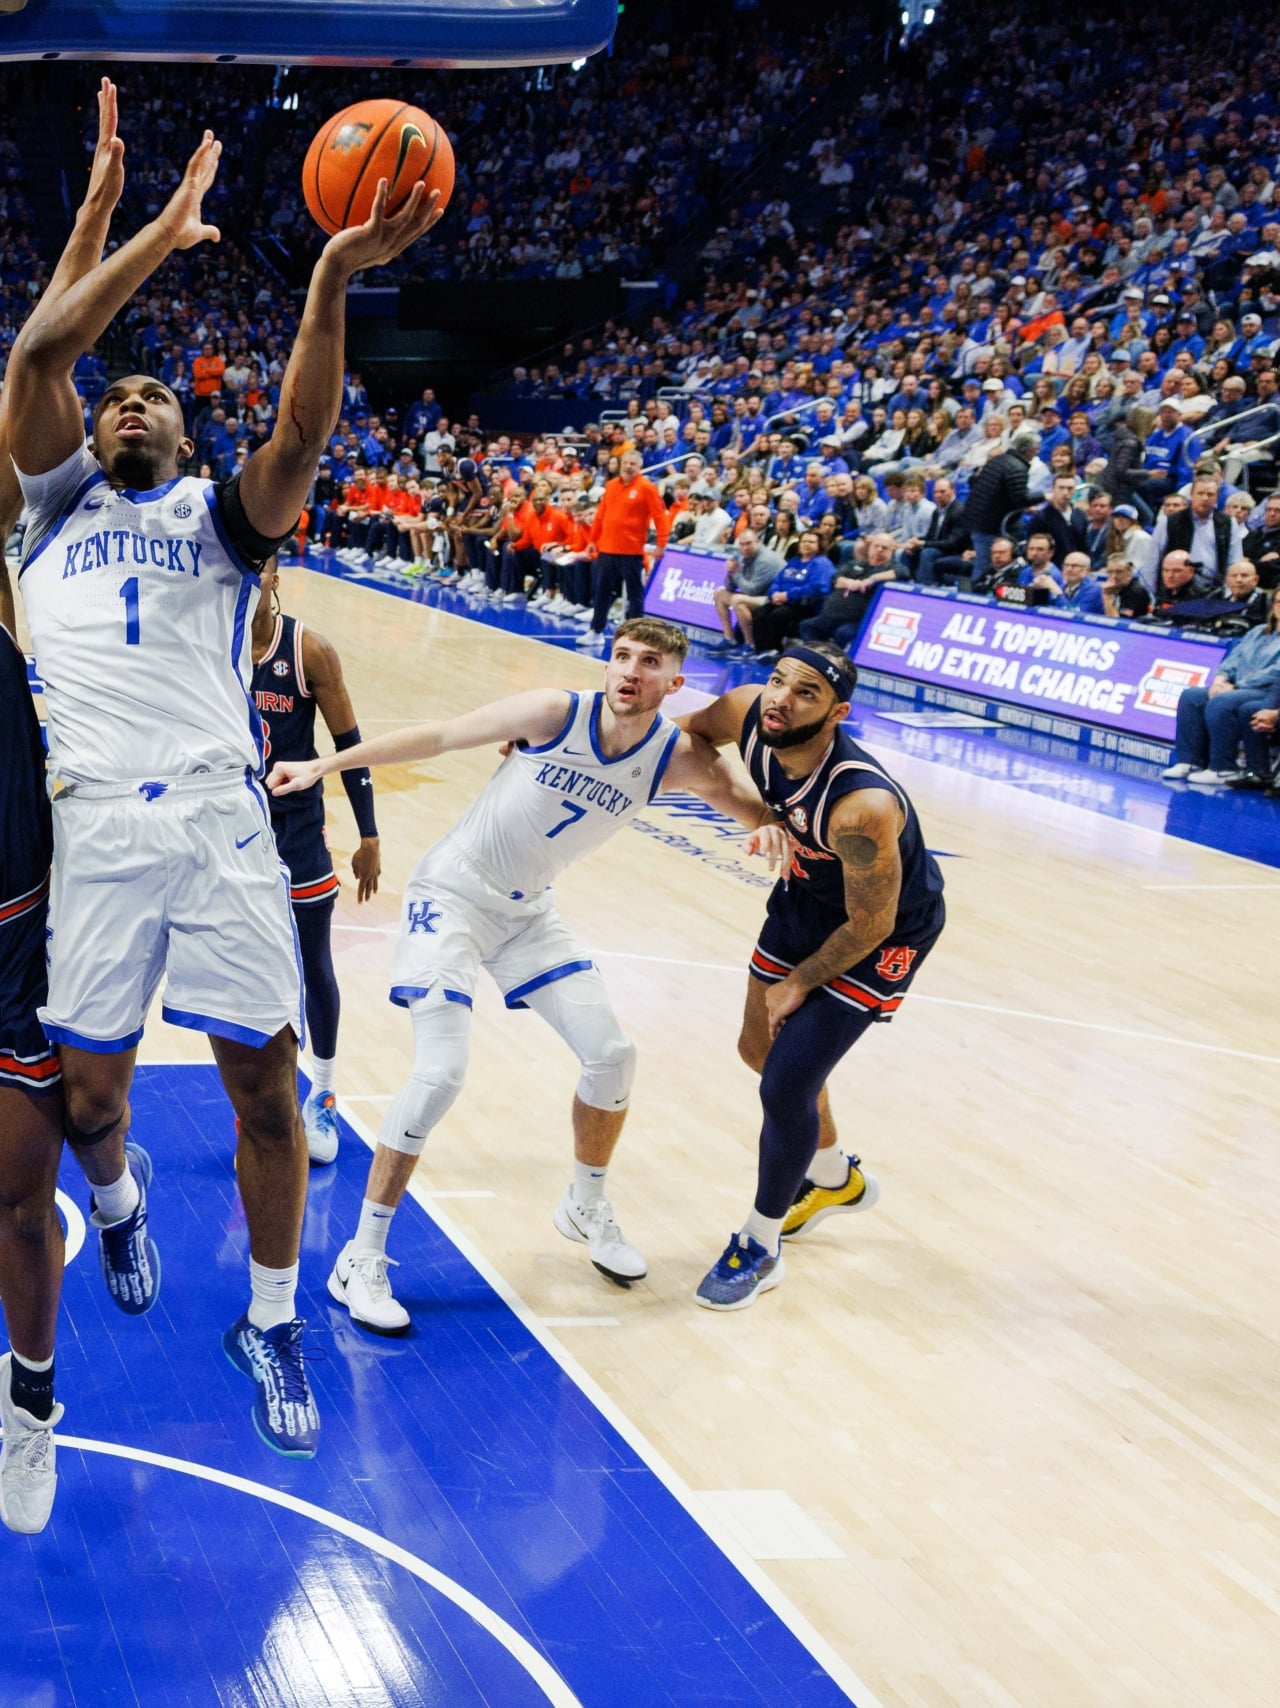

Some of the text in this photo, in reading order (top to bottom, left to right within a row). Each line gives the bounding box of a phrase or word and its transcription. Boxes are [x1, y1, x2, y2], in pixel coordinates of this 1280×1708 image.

[174, 503, 192, 519] SEC
[62, 530, 202, 580] KENTUCKY
[119, 576, 140, 645] 1
[940, 612, 987, 646] ALL
[990, 620, 1121, 672] TOPPINGS
[272, 660, 290, 676] SEC
[906, 640, 1132, 715] NO EXTRA CHARGE
[535, 763, 633, 816] KENTUCKY
[545, 800, 588, 838] 7
[408, 900, 443, 936] UK
